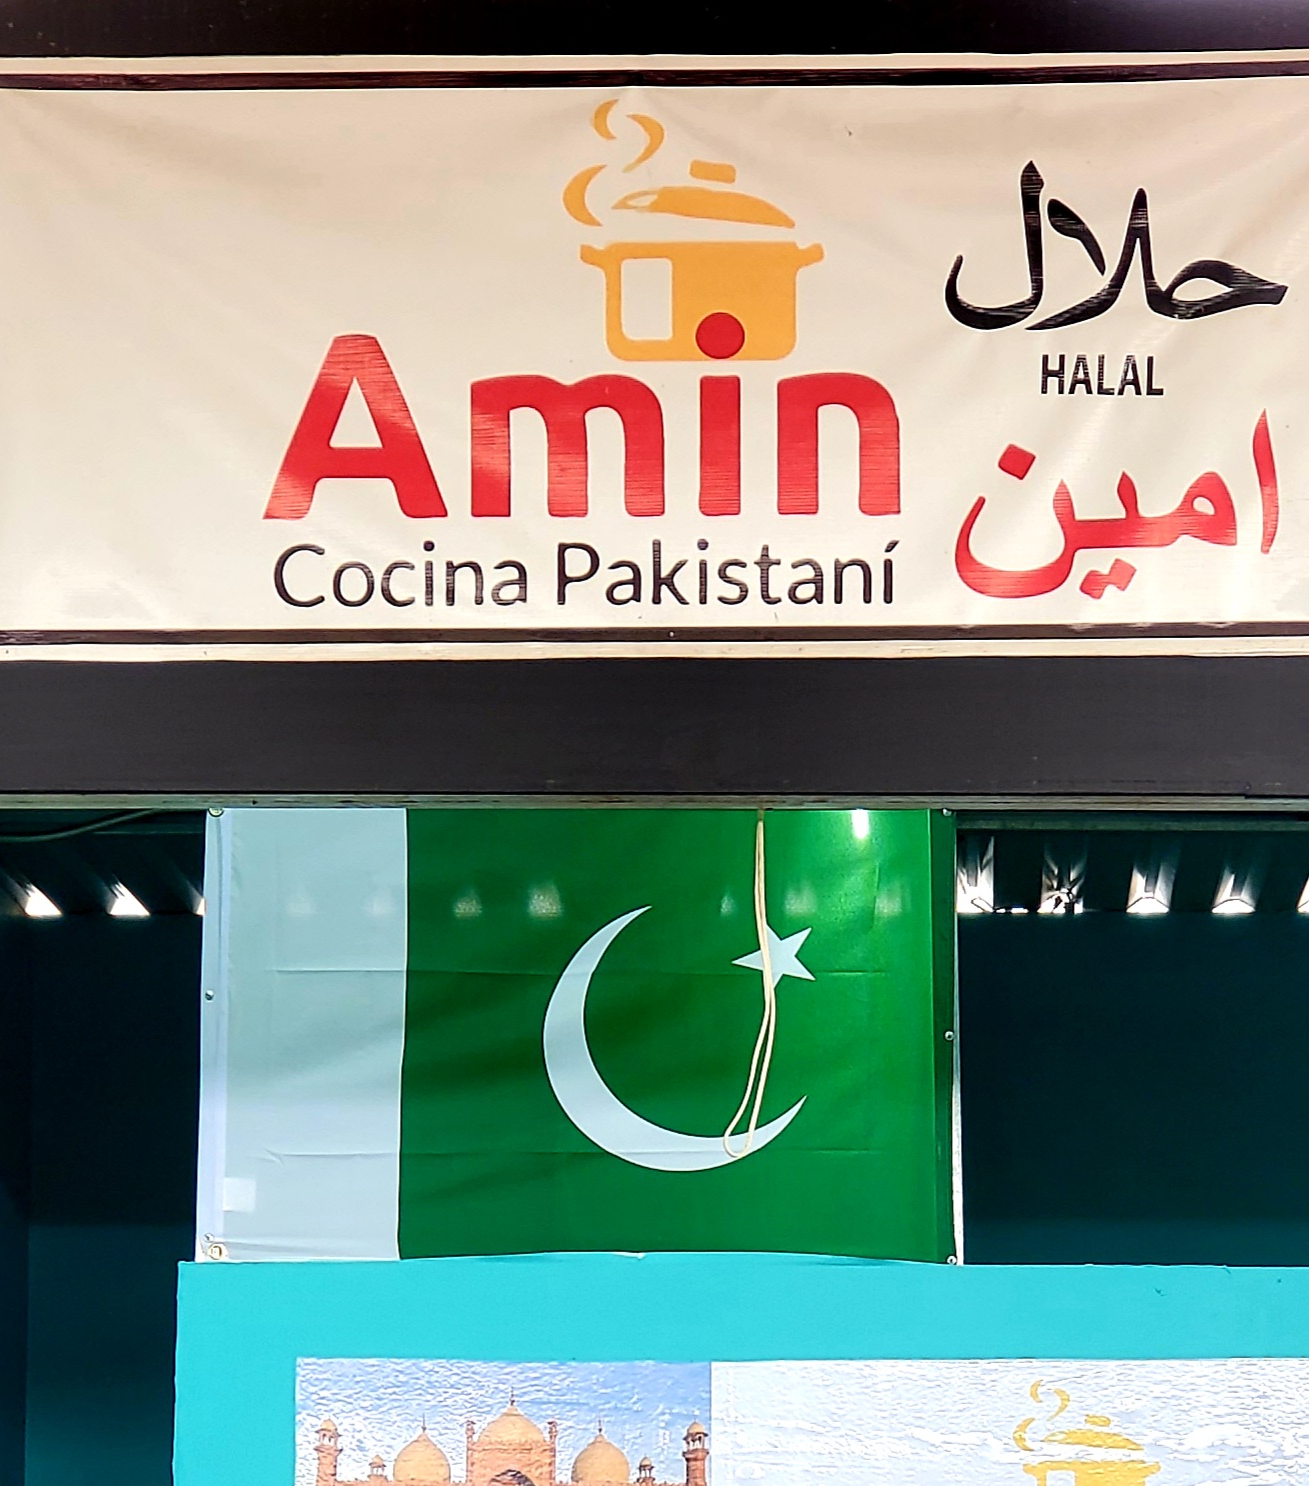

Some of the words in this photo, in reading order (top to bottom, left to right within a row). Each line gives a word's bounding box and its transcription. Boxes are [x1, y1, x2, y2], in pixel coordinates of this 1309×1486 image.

[945, 159, 1289, 332] حلال
[264, 311, 902, 520] Amin
[1040, 353, 1165, 397] HALAL
[274, 541, 529, 608] Cocina
[556, 540, 899, 607] Pakistaní
